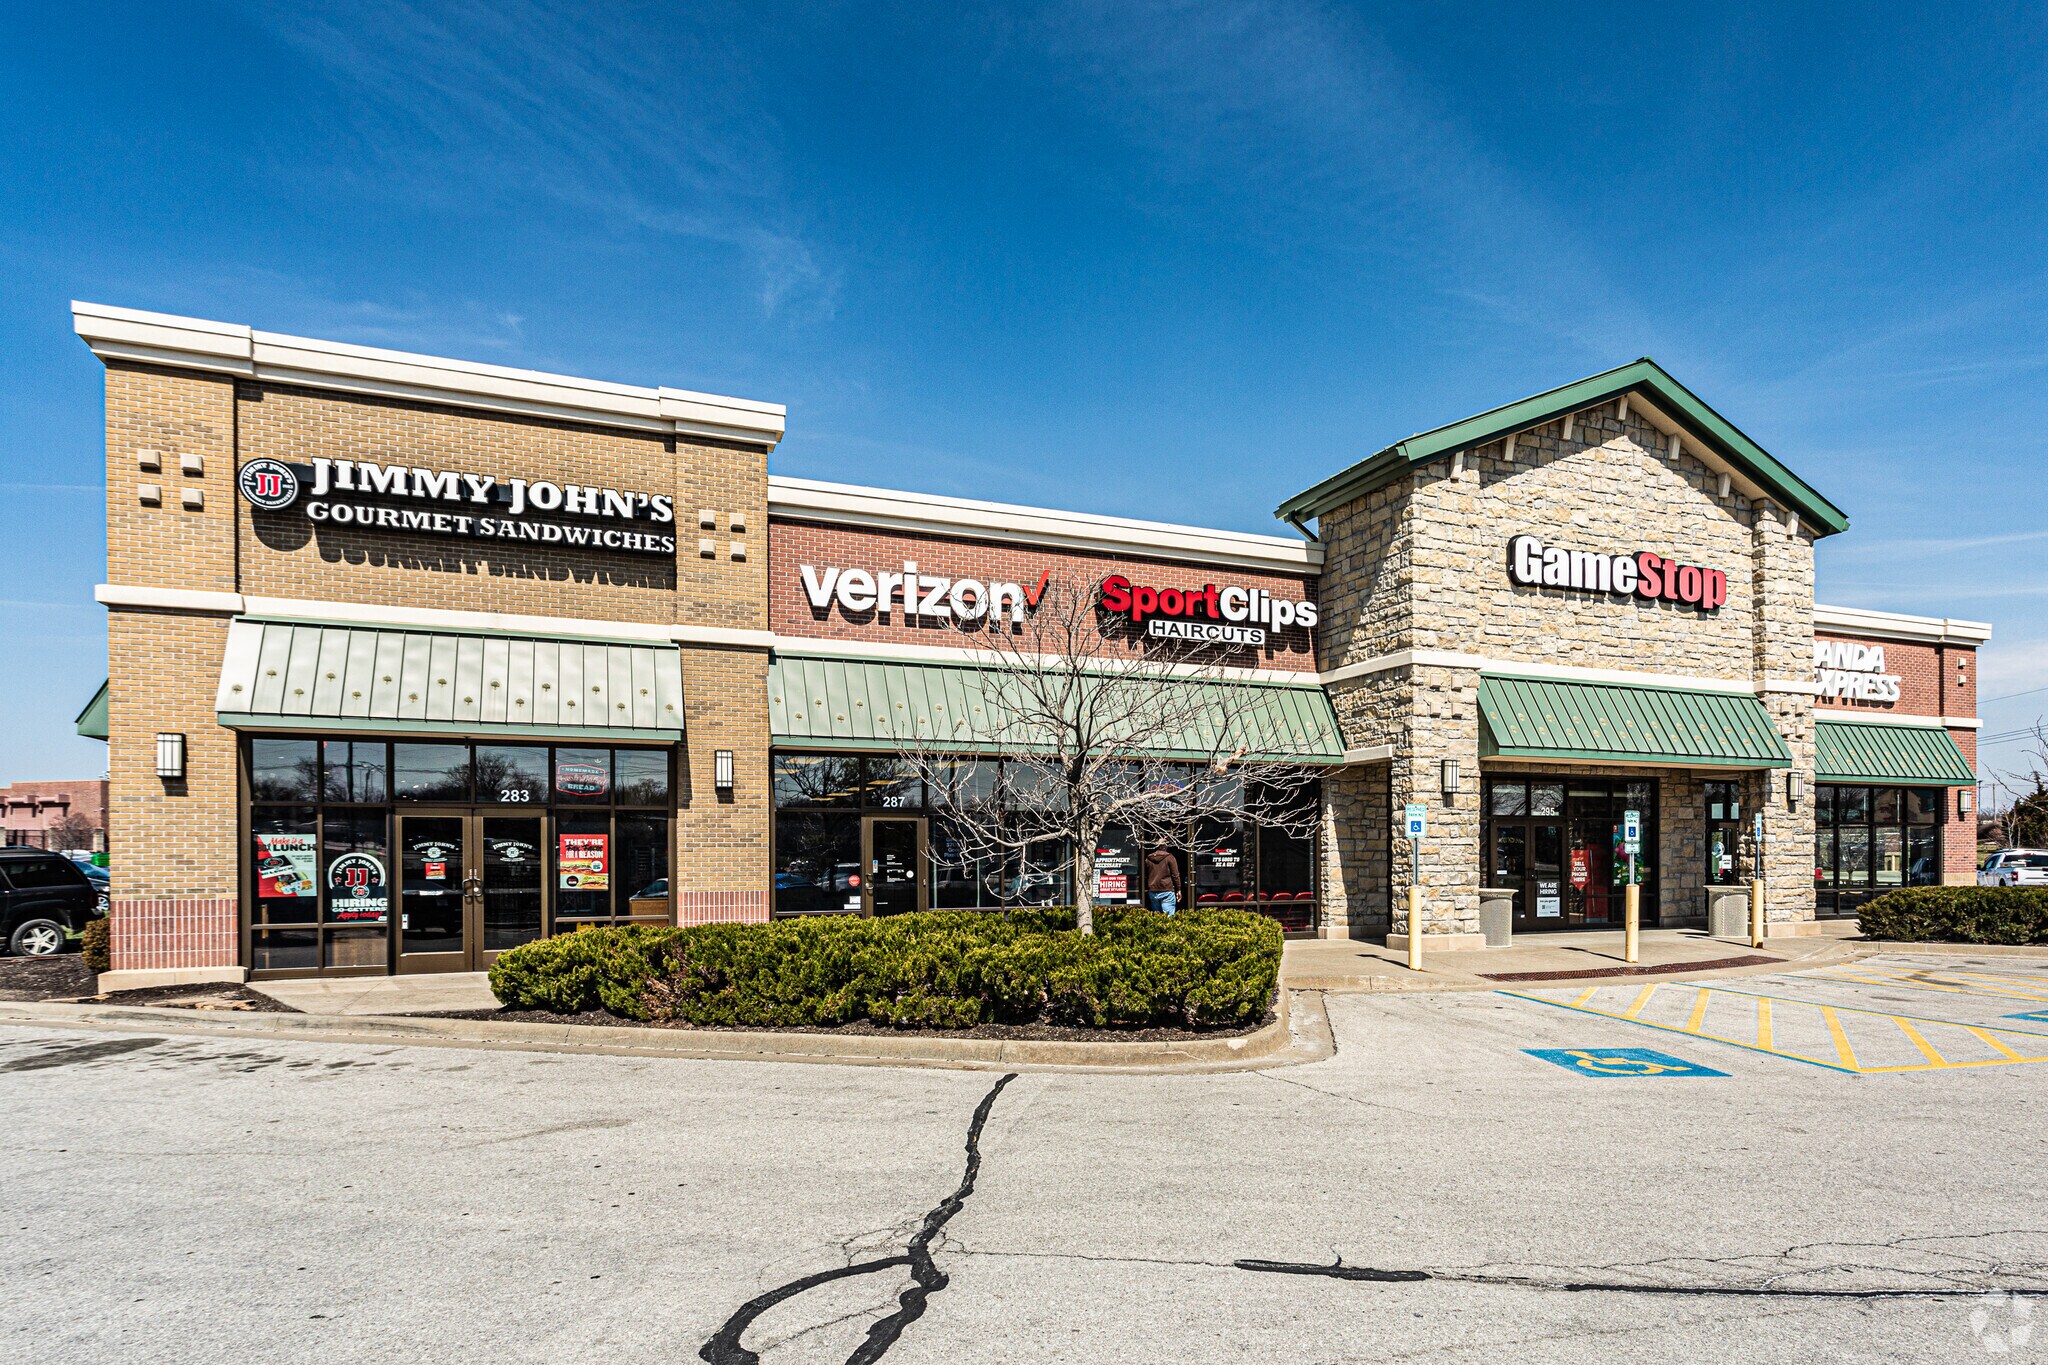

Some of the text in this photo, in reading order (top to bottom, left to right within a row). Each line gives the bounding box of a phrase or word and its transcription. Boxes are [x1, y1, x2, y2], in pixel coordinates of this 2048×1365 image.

[243, 462, 294, 484] JIMMY JOHN'S
[256, 472, 283, 497] JJ
[311, 457, 674, 523] JIMMY JOHN'S
[306, 501, 675, 553] GOURMET SANDWICHES
[1515, 535, 1727, 609] GameStop
[800, 561, 1024, 623] verizon
[1101, 575, 1318, 632] SportClips
[1152, 621, 1263, 643] HAIRCUTS
[1813, 641, 1886, 672] ANDA
[1813, 669, 1902, 701] XPRESS
[501, 789, 530, 802] 283
[567, 783, 595, 791] BREAD
[883, 796, 905, 808] 287
[1541, 806, 1555, 816] 295
[273, 843, 317, 851] LUNCH
[564, 838, 604, 846] THEY'RE
[579, 850, 604, 859] REASON
[335, 859, 378, 875] JIMMY JOHN'S
[345, 867, 369, 887] JJ
[332, 897, 388, 908] HIRING
